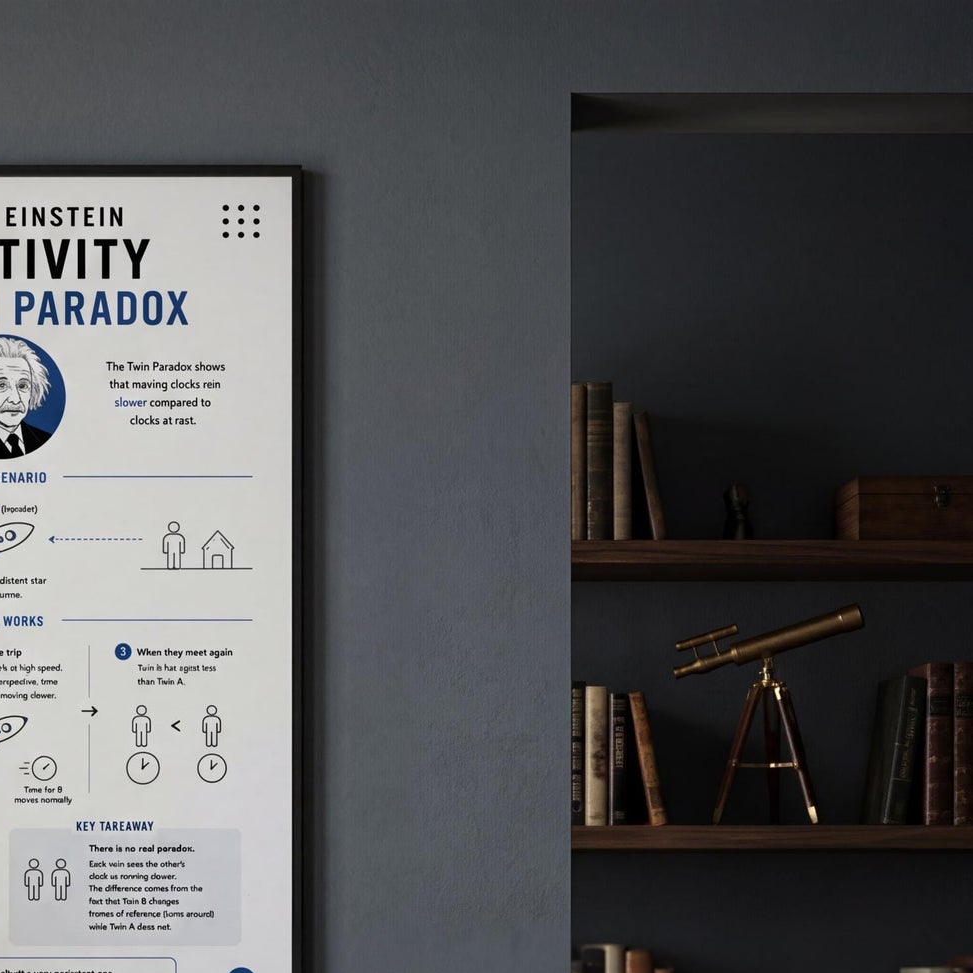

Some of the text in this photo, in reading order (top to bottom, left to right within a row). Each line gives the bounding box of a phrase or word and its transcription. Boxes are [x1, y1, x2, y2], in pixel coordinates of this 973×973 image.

[5, 206, 123, 227] EINSTEIN
[14, 290, 189, 326] PARADOX
[105, 361, 226, 372] The Twin Paradox shows
[109, 378, 130, 389] that
[132, 379, 168, 393] maving
[170, 378, 201, 390] clocks
[114, 396, 212, 410] slower compared to
[129, 414, 197, 426] clocks at rast.
[30, 577, 47, 585] star
[2, 615, 44, 627] WORKS
[6, 648, 22, 659] trip
[163, 647, 184, 659] they
[185, 649, 207, 657] meet
[209, 647, 233, 659] again
[19, 663, 36, 674] high
[37, 663, 63, 674] speed.
[137, 677, 156, 686] than
[0, 691, 29, 702] moving
[44, 785, 56, 794] for
[76, 821, 96, 832] KEY
[88, 844, 114, 853] There
[115, 844, 123, 853] is
[145, 860, 159, 868] the
[88, 884, 103, 893] The
[170, 884, 189, 893] from
[190, 884, 203, 892] the
[115, 909, 125, 918] of
[128, 922, 136, 931] A
